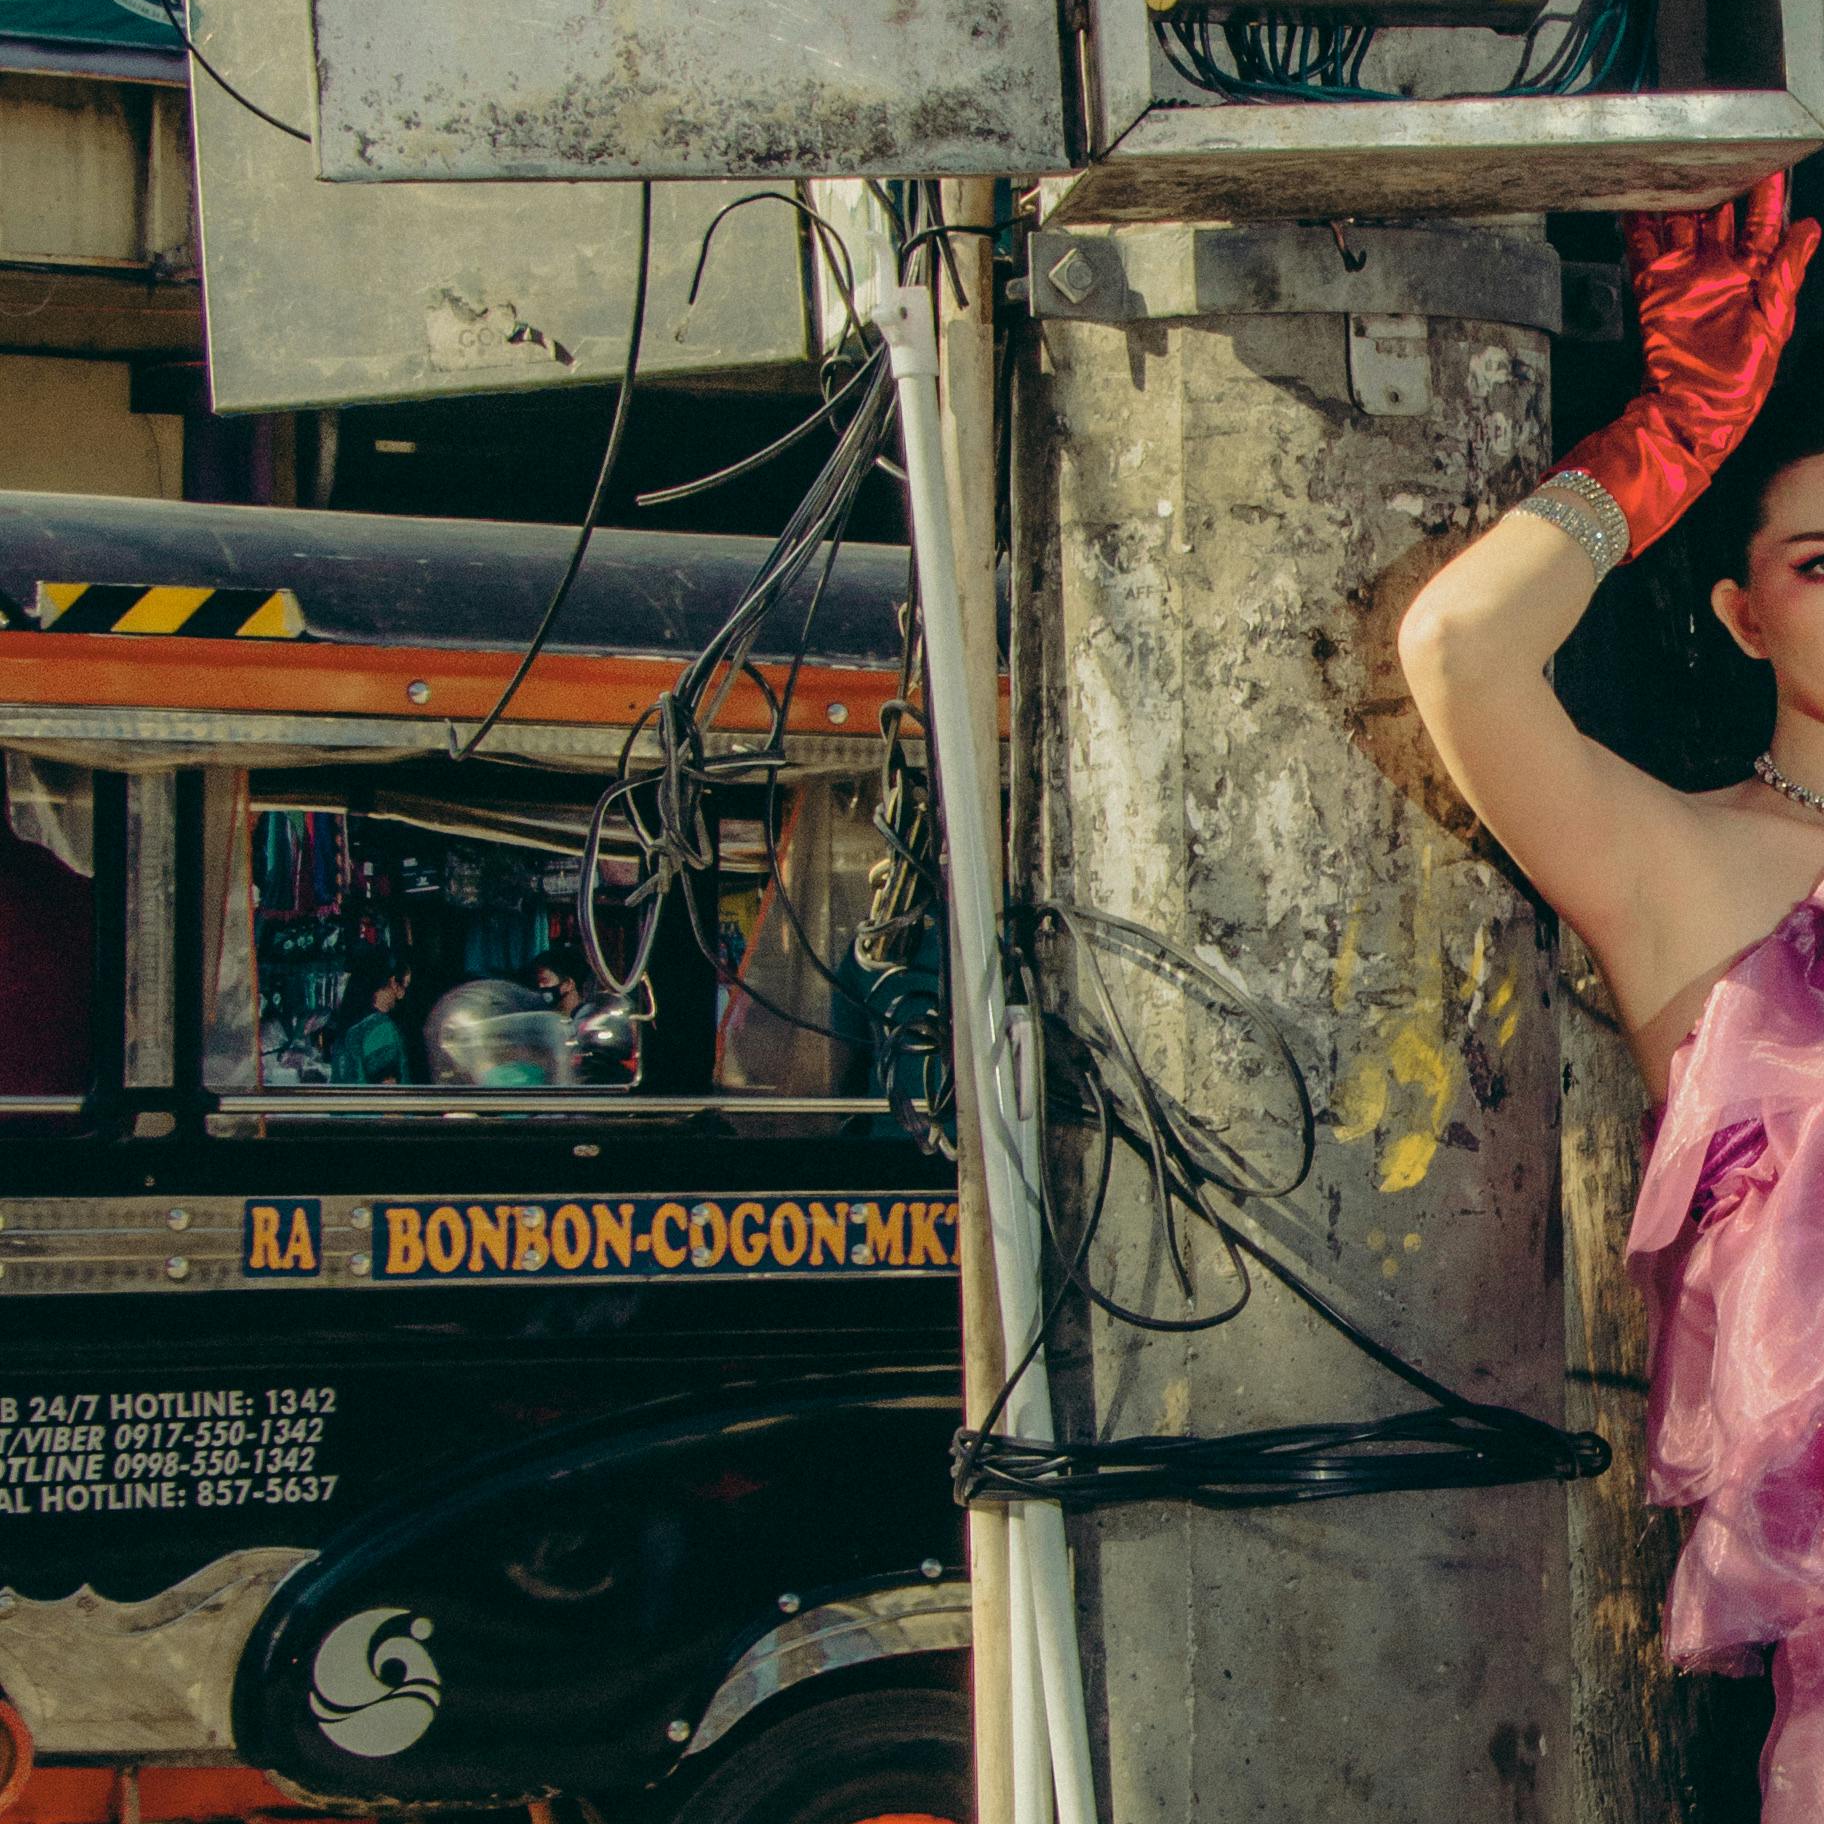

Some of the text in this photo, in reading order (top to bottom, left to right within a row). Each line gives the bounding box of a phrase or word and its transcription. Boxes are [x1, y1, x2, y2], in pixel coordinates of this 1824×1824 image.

[249, 1205, 316, 1270] RA
[28, 1394, 101, 1425] 24/7
[109, 1390, 256, 1421] HOTLINE:
[265, 1386, 338, 1416] 1342
[114, 1417, 325, 1451] 0917-550-1342
[113, 1445, 317, 1479] 0998-550-1342
[40, 1481, 188, 1514] HOTLINE:
[195, 1474, 340, 1508] 857-5637
